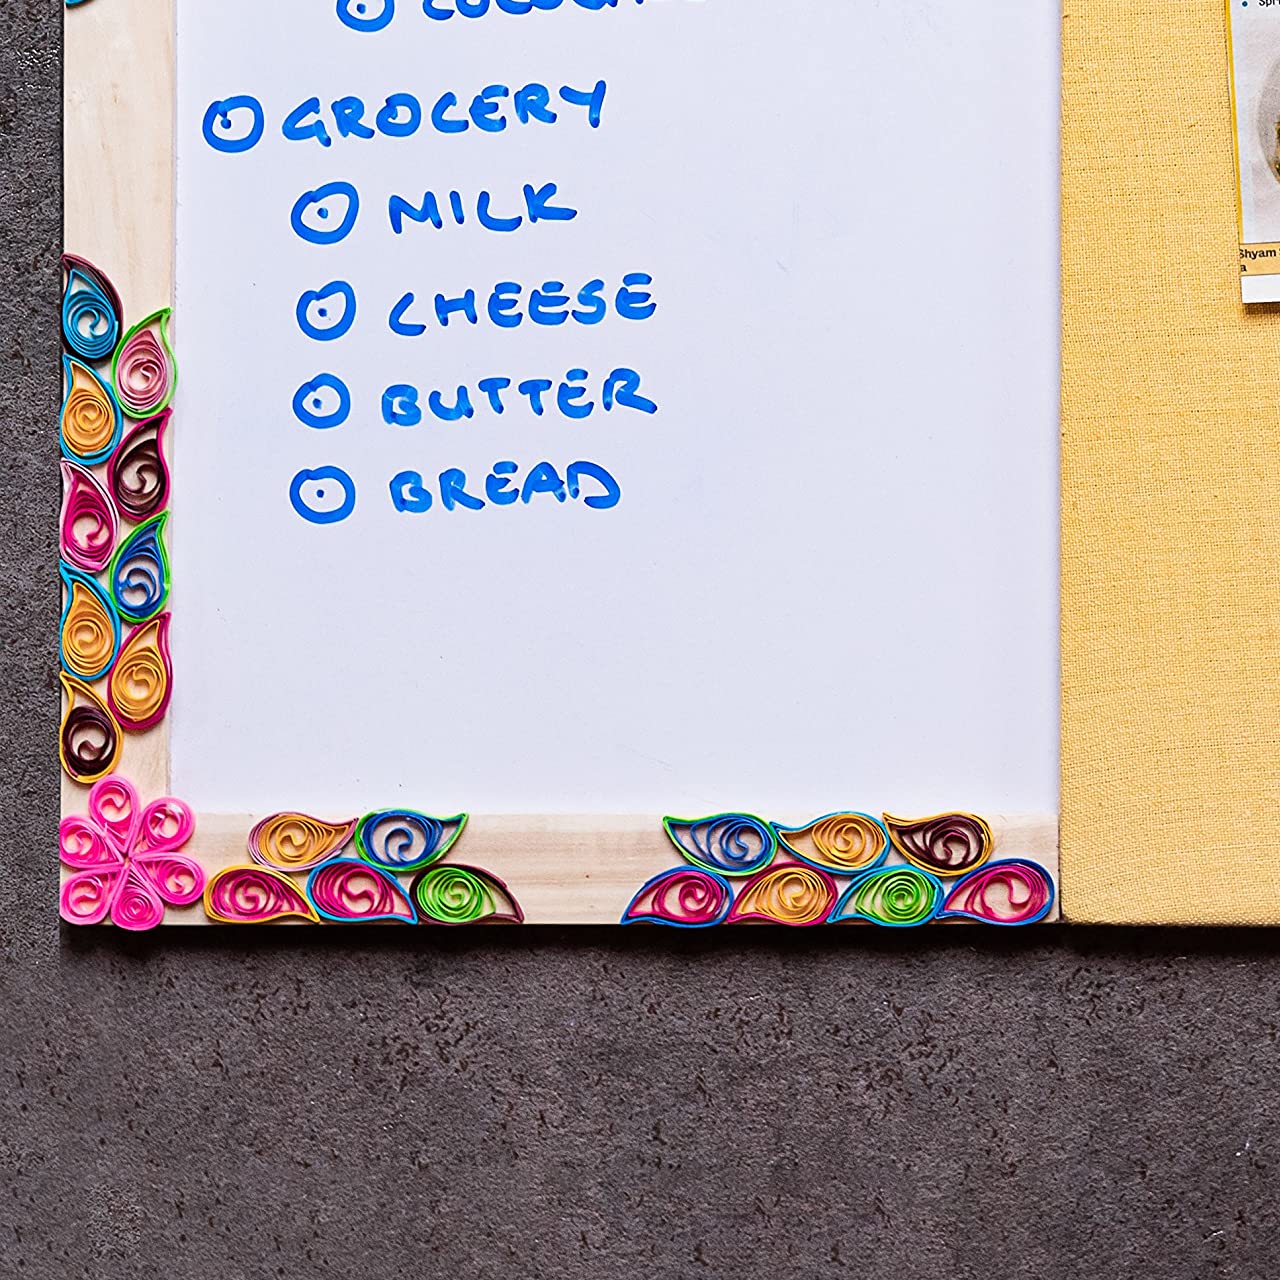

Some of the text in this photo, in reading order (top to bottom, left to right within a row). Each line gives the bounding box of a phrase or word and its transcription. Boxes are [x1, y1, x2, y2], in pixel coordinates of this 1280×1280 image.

[282, 80, 606, 148] GROCERY
[388, 183, 576, 234] MILK
[389, 272, 656, 336] CHEESE
[381, 368, 657, 427] BUTTER
[389, 461, 621, 513] BREAD
